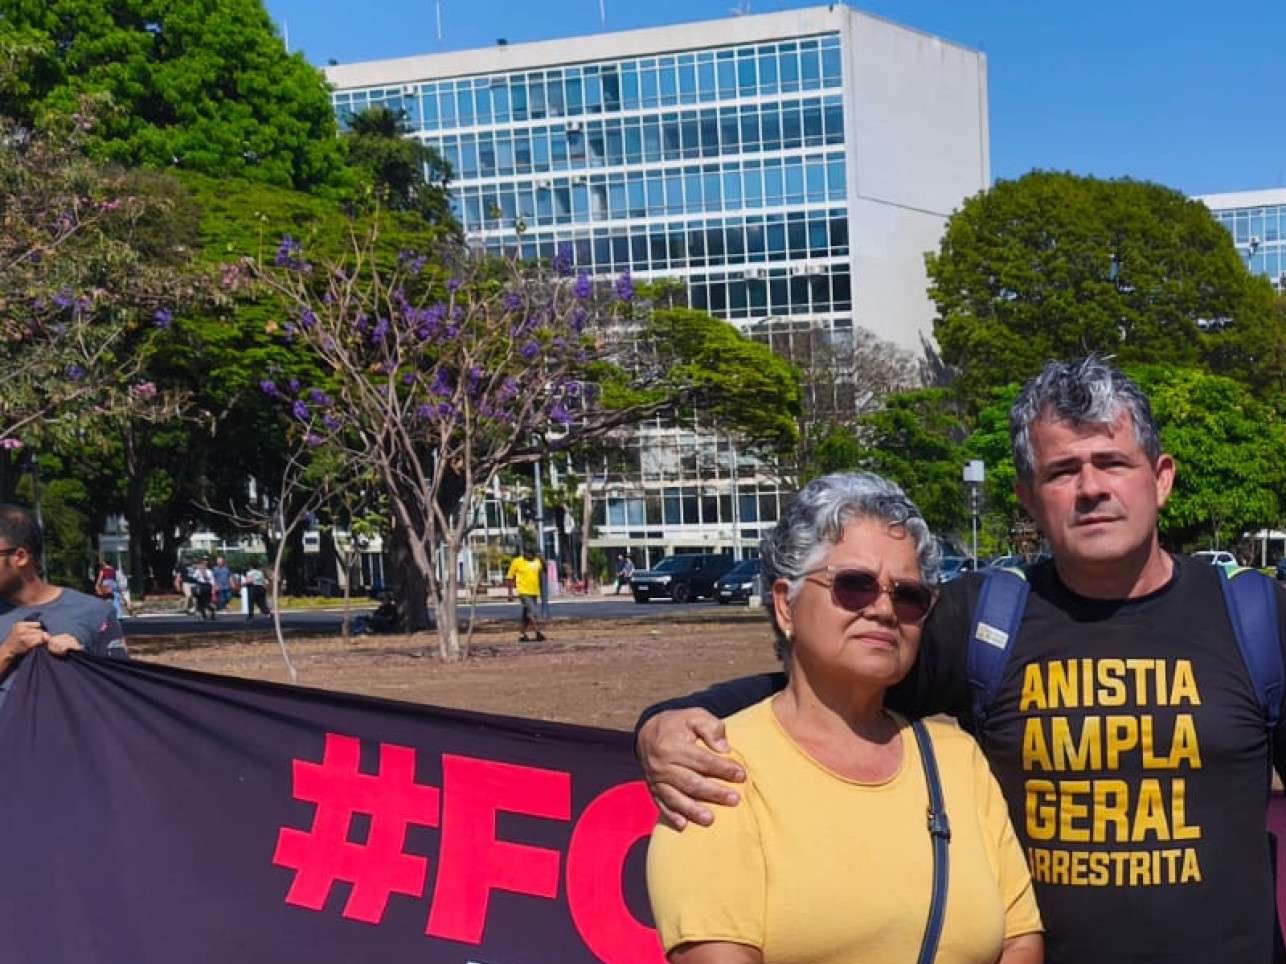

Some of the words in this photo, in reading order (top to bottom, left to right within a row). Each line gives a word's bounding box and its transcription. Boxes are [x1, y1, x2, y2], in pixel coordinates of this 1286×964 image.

[1018, 658, 1202, 712] ANISTIA
[1022, 713, 1203, 771] AMPLA
[1024, 777, 1203, 843] GERAL
